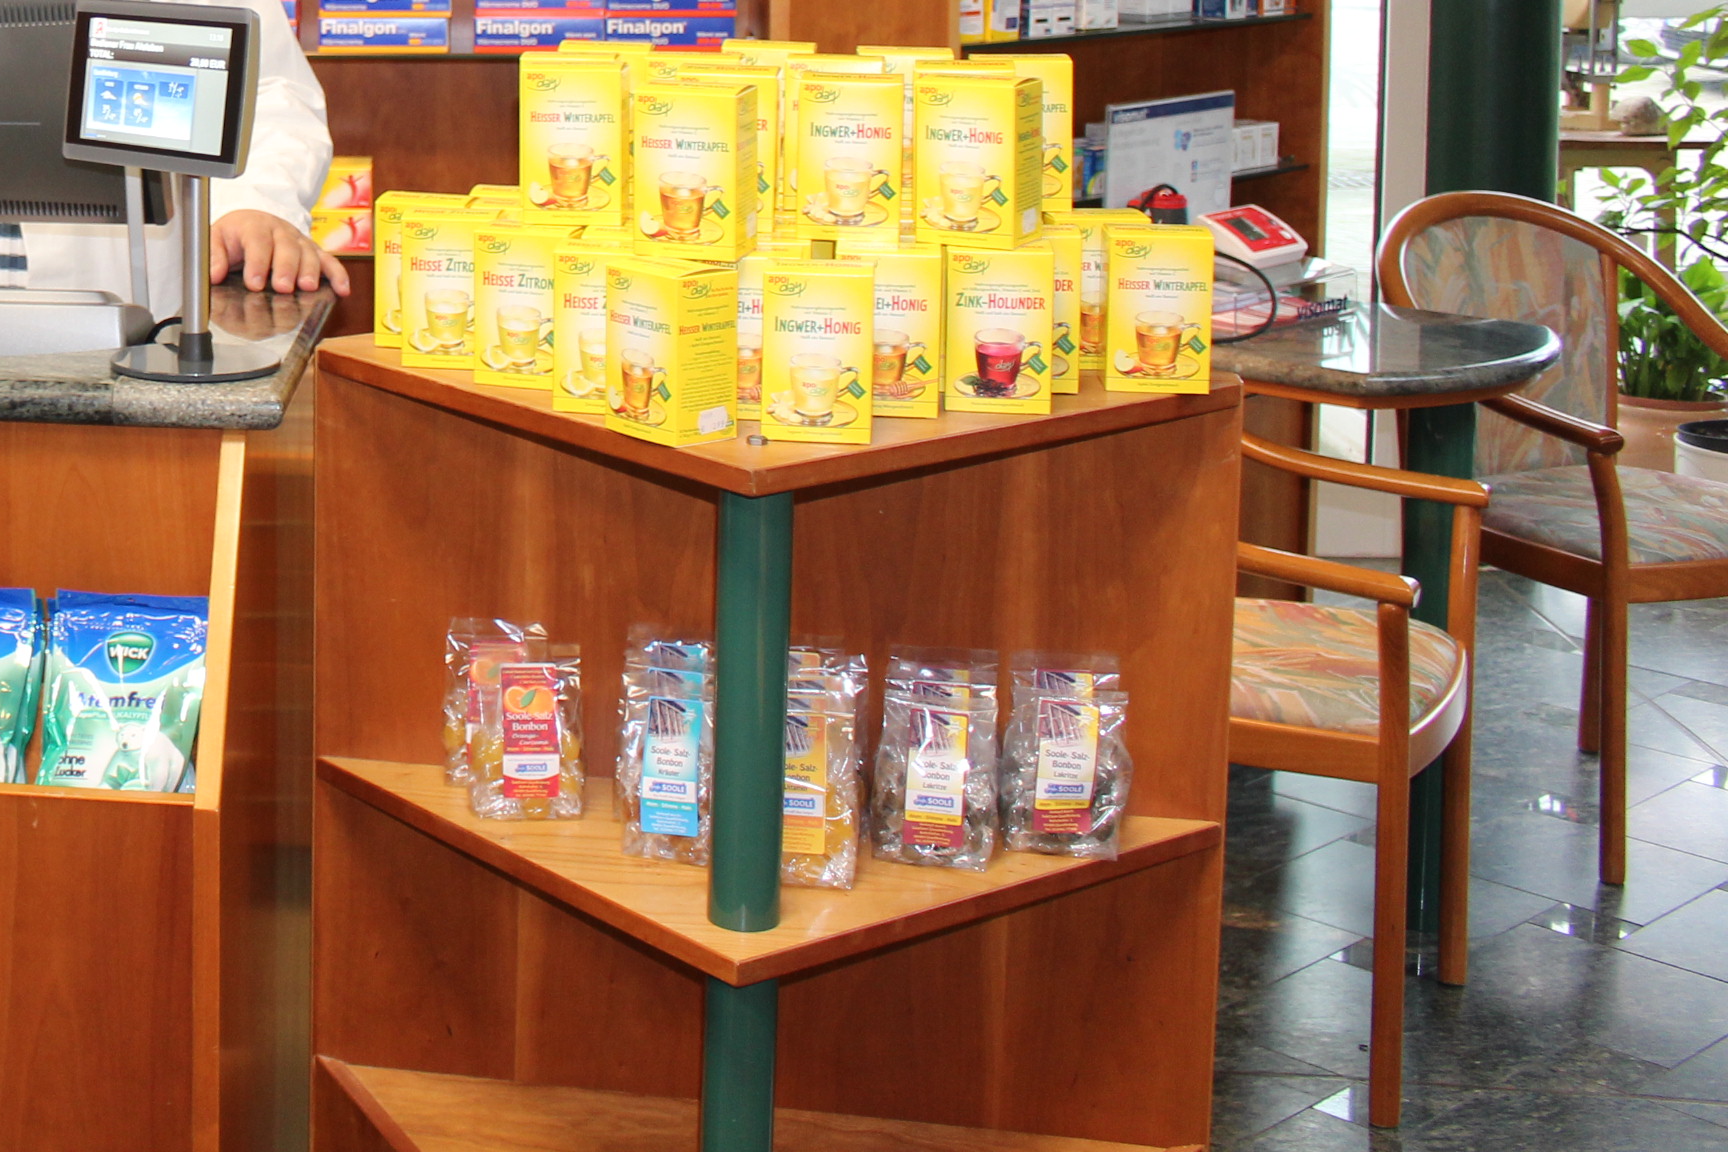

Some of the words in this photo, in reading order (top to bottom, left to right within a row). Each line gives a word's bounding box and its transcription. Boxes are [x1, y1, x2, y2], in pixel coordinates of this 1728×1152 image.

[321, 20, 398, 37] Finalgon
[476, 17, 553, 37] Finalgon
[607, 19, 685, 37] Finalgon
[527, 72, 545, 83] apo
[804, 84, 823, 94] apo
[920, 85, 937, 95] apo
[638, 94, 656, 105] apo
[530, 111, 561, 123] HEISSER
[563, 112, 616, 124] WINTERAPFEL
[810, 121, 892, 140] INGWER+HONIG
[925, 124, 1004, 144] INGWER+HONIG
[641, 136, 672, 150] HEISSER
[675, 138, 730, 153] WINTERAPFEL
[380, 206, 396, 215] apo
[405, 221, 423, 230] apo
[478, 235, 496, 244] apo
[1116, 239, 1134, 249] apo
[559, 255, 577, 264] apo
[953, 254, 971, 264] apo
[410, 257, 442, 272] HEISSE
[446, 258, 475, 273] ZITRO
[608, 268, 621, 278] apo
[483, 271, 515, 287] HEISSE
[518, 274, 554, 290] ZITRON
[683, 279, 698, 290] apo
[768, 275, 789, 285] apo
[1118, 278, 1151, 290] HEISSER
[1153, 280, 1208, 292] WINTERAPFEL
[564, 293, 598, 309] HEISSE
[876, 295, 928, 312] EI+HONIG
[955, 292, 1046, 310] ZINK-HOLUNDER
[775, 316, 862, 335] INGWER+HONIG
[110, 645, 150, 660] WICK
[512, 722, 548, 731] Bonbon
[57, 752, 85, 766] ohne
[657, 757, 683, 767] Bonbon
[1052, 760, 1082, 769] Bonbon
[662, 784, 685, 793] SOOLE
[789, 799, 813, 808] SOOLE
[928, 797, 952, 807] SOOLE
